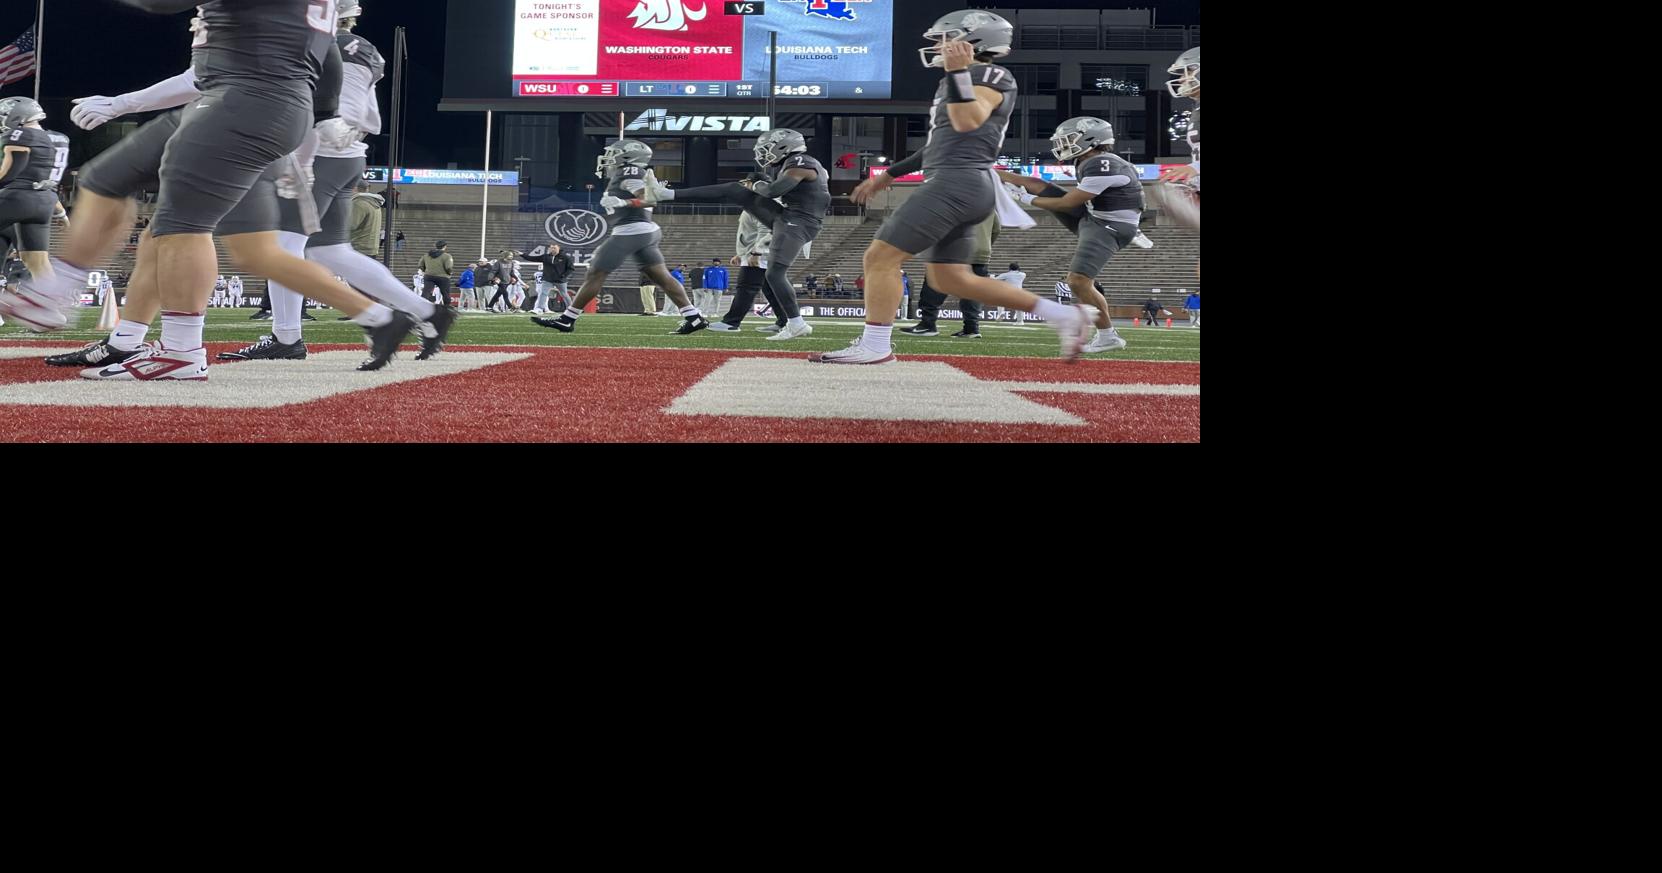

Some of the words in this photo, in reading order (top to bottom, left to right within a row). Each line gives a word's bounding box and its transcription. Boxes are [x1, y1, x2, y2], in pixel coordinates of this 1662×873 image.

[734, 3, 754, 13] VS
[344, 38, 359, 55] 4
[605, 46, 690, 54] WASHINGTON
[693, 46, 733, 54] STATE
[835, 46, 868, 54] TECH
[982, 66, 1005, 84] 17
[524, 84, 557, 93] WSU
[640, 85, 654, 93] LT
[624, 108, 770, 132] AVISTA
[10, 129, 23, 141] 9
[49, 146, 69, 181] 9
[795, 156, 805, 166] 2
[1100, 159, 1110, 172] 3
[623, 166, 639, 176] 28
[820, 307, 834, 316] THE
[838, 307, 866, 317] OFFICIA
